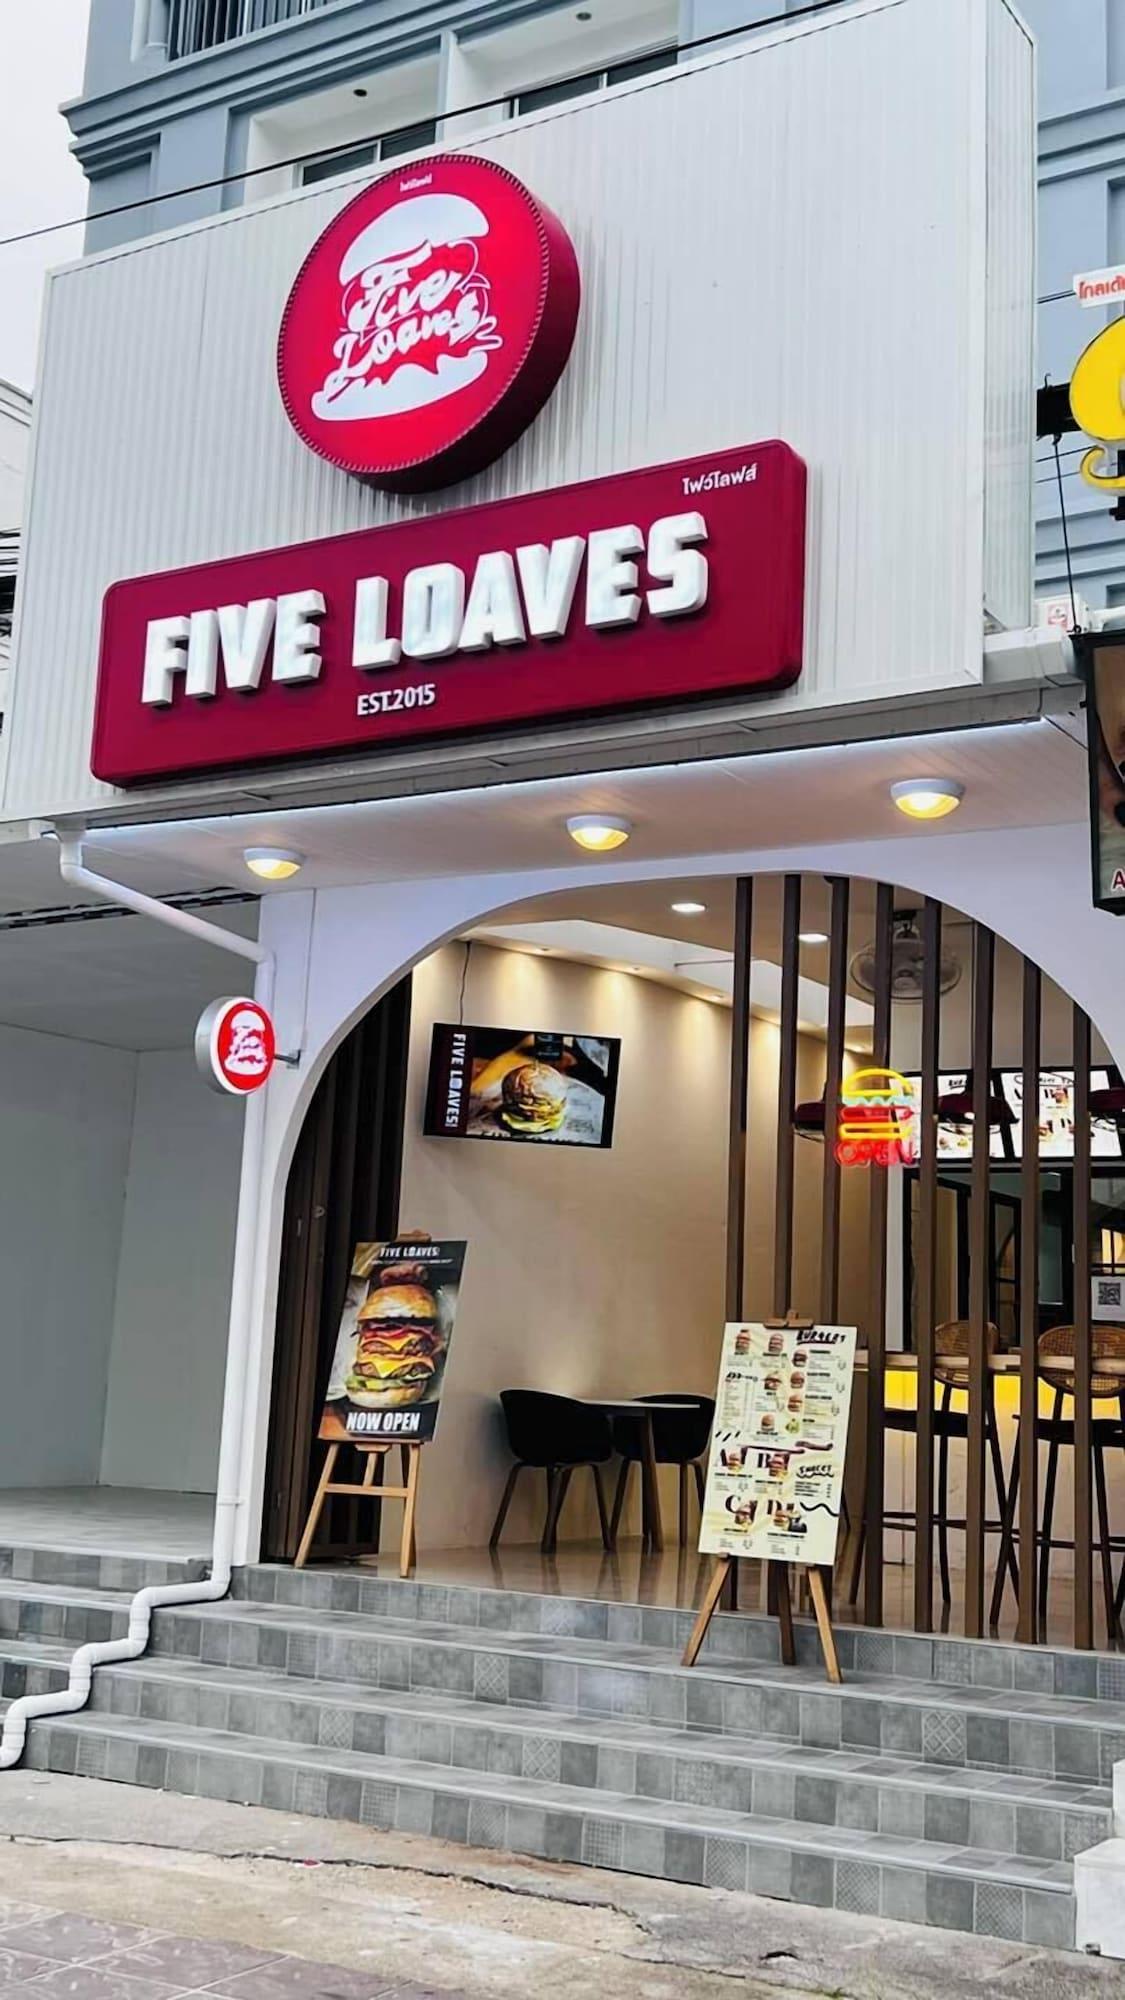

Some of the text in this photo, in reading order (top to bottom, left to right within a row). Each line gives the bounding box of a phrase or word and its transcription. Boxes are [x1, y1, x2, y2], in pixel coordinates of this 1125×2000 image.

[142, 511, 709, 708] FIVE LOAVES
[357, 683, 436, 716] EST.2015
[450, 1033, 466, 1065] FIVE
[380, 1247, 401, 1257] FIVE
[346, 1411, 420, 1431] NOW OPEN
